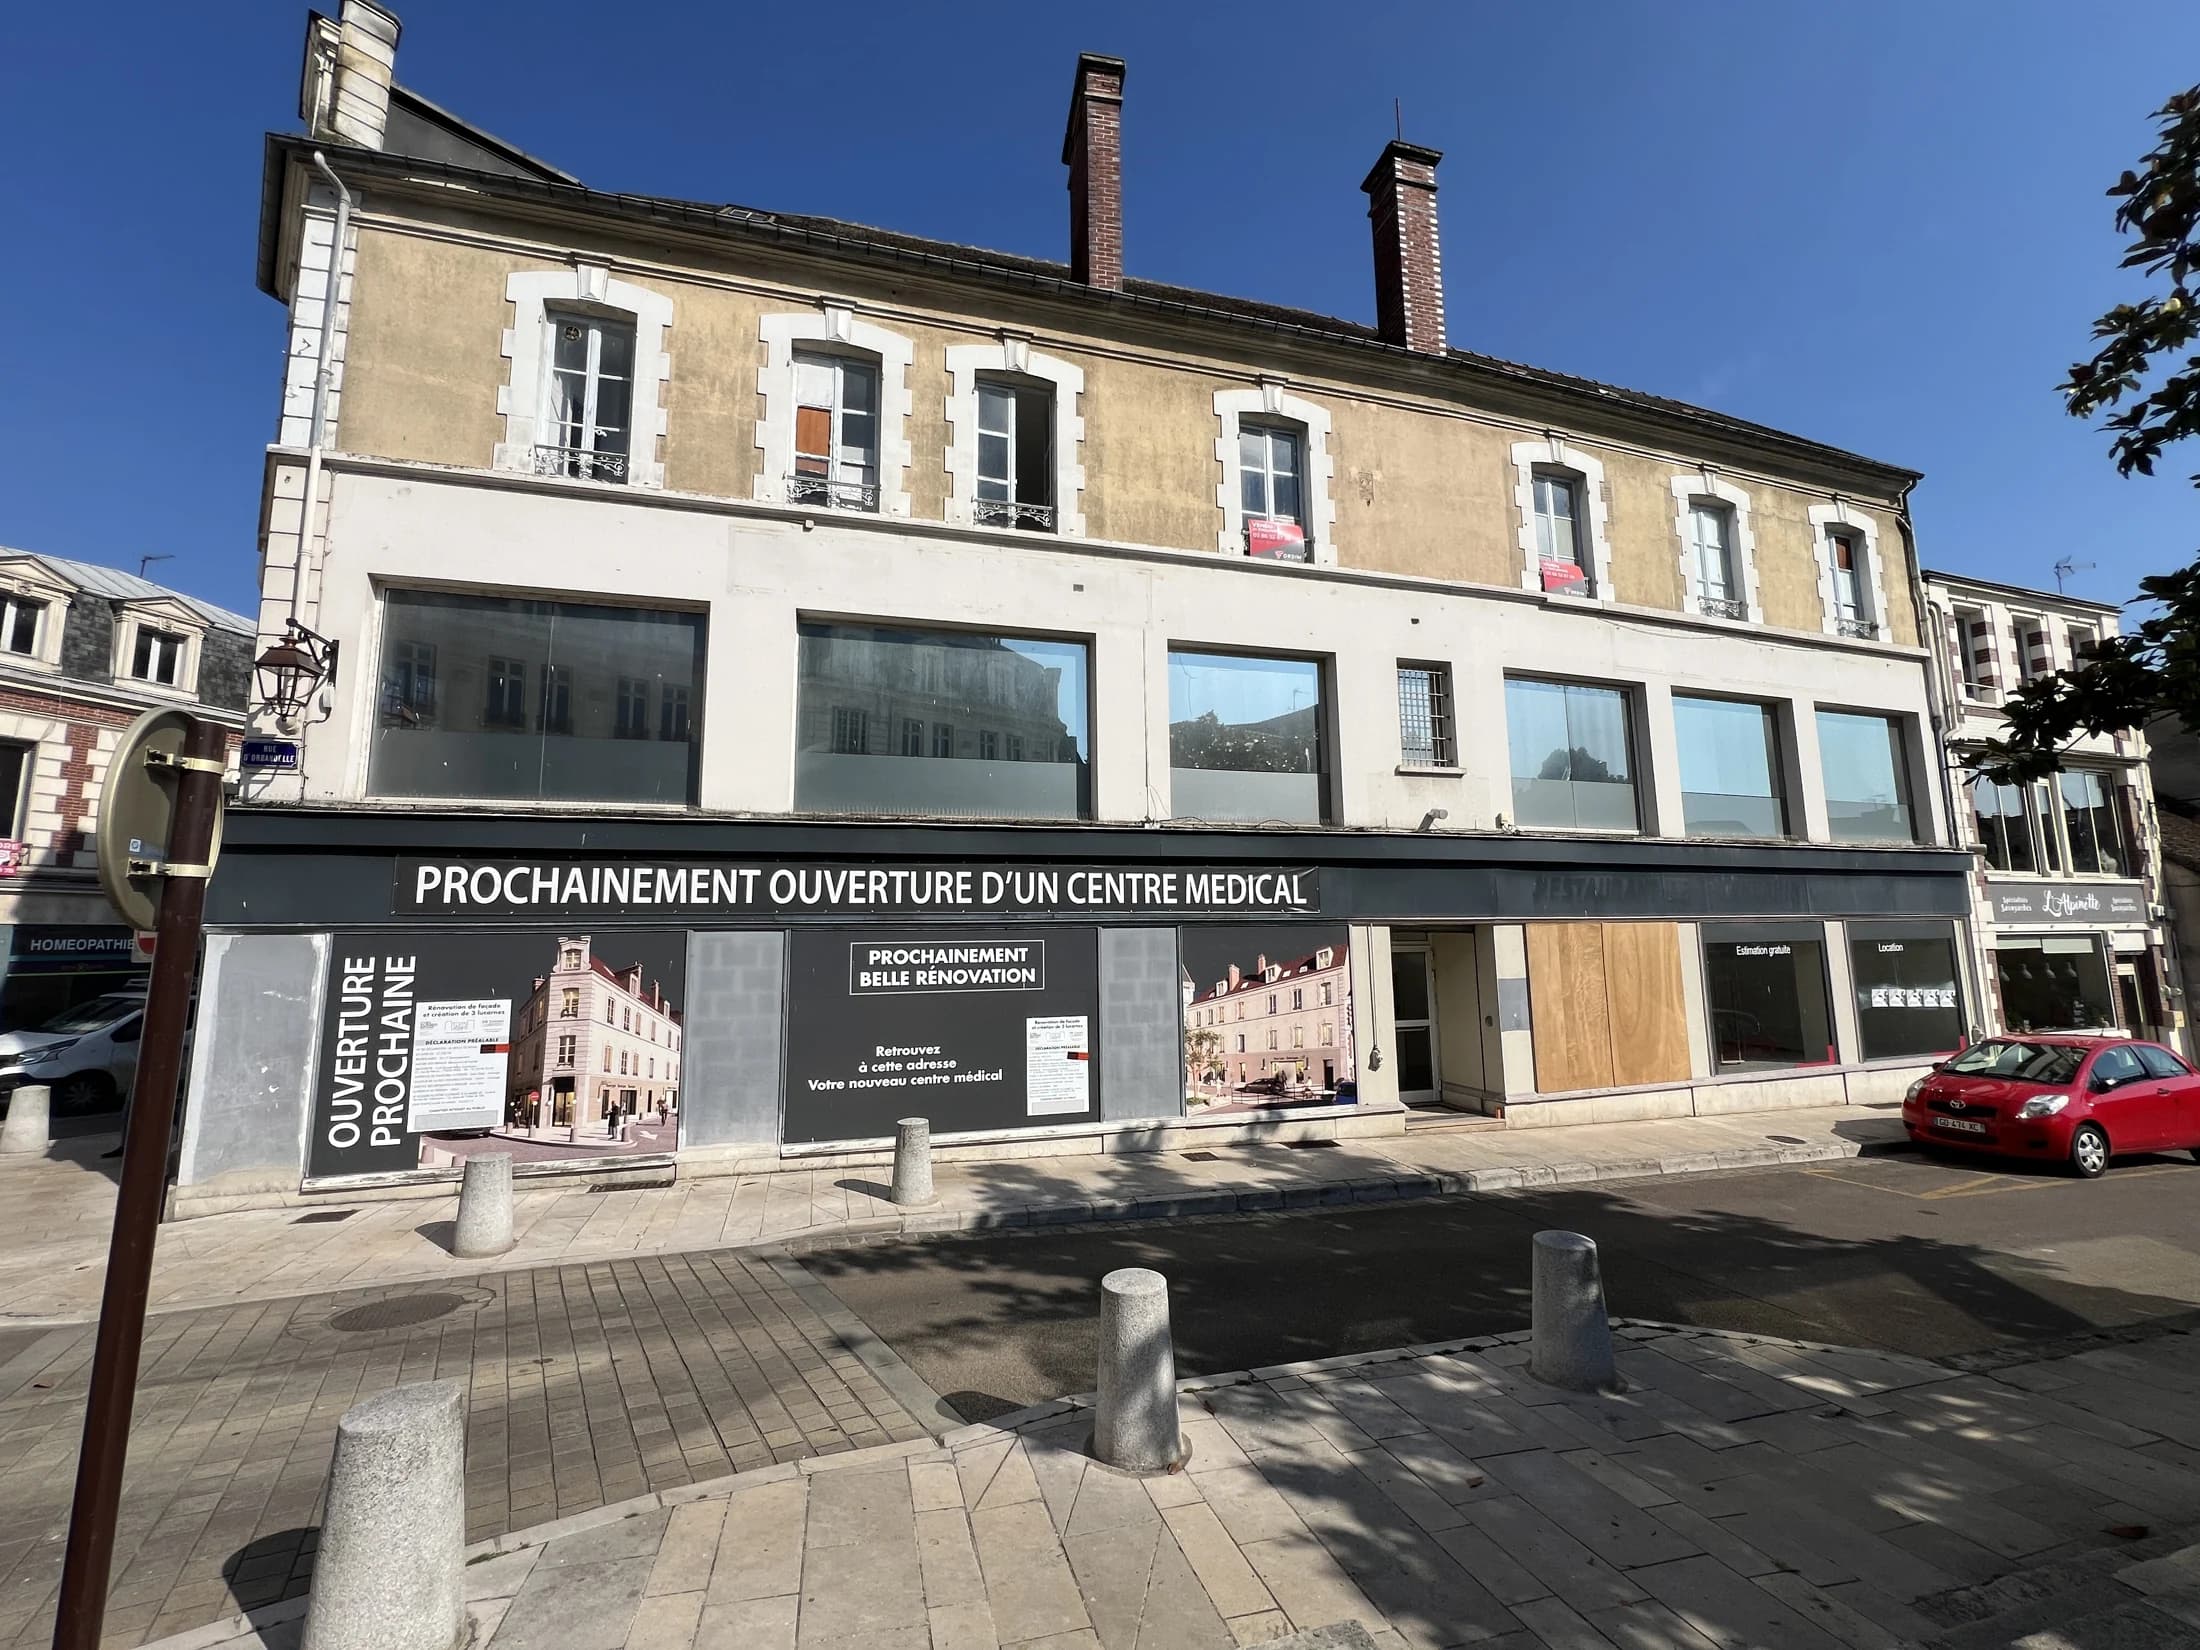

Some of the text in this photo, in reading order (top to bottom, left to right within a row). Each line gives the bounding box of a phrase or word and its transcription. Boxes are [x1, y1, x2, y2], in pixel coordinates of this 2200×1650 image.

[415, 865, 1308, 905] PROCHAINEMENT OUVERTURE D'UN CENTRE MEDICAL
[30, 938, 134, 951] HOMEOPATHIE
[1736, 945, 1792, 957] Estimation gratuite
[1878, 943, 1904, 952] Location
[868, 947, 1029, 966] PROCHAINEMENT
[859, 965, 1036, 987] BELLE RÉNOVATION
[328, 956, 376, 1149] OUVERTURE
[370, 955, 417, 1147] PROCHAINE
[875, 1045, 941, 1057] Retrouvez
[858, 1058, 957, 1073] à cette adresse
[808, 1069, 1003, 1091] Votre nouveau centre médical
